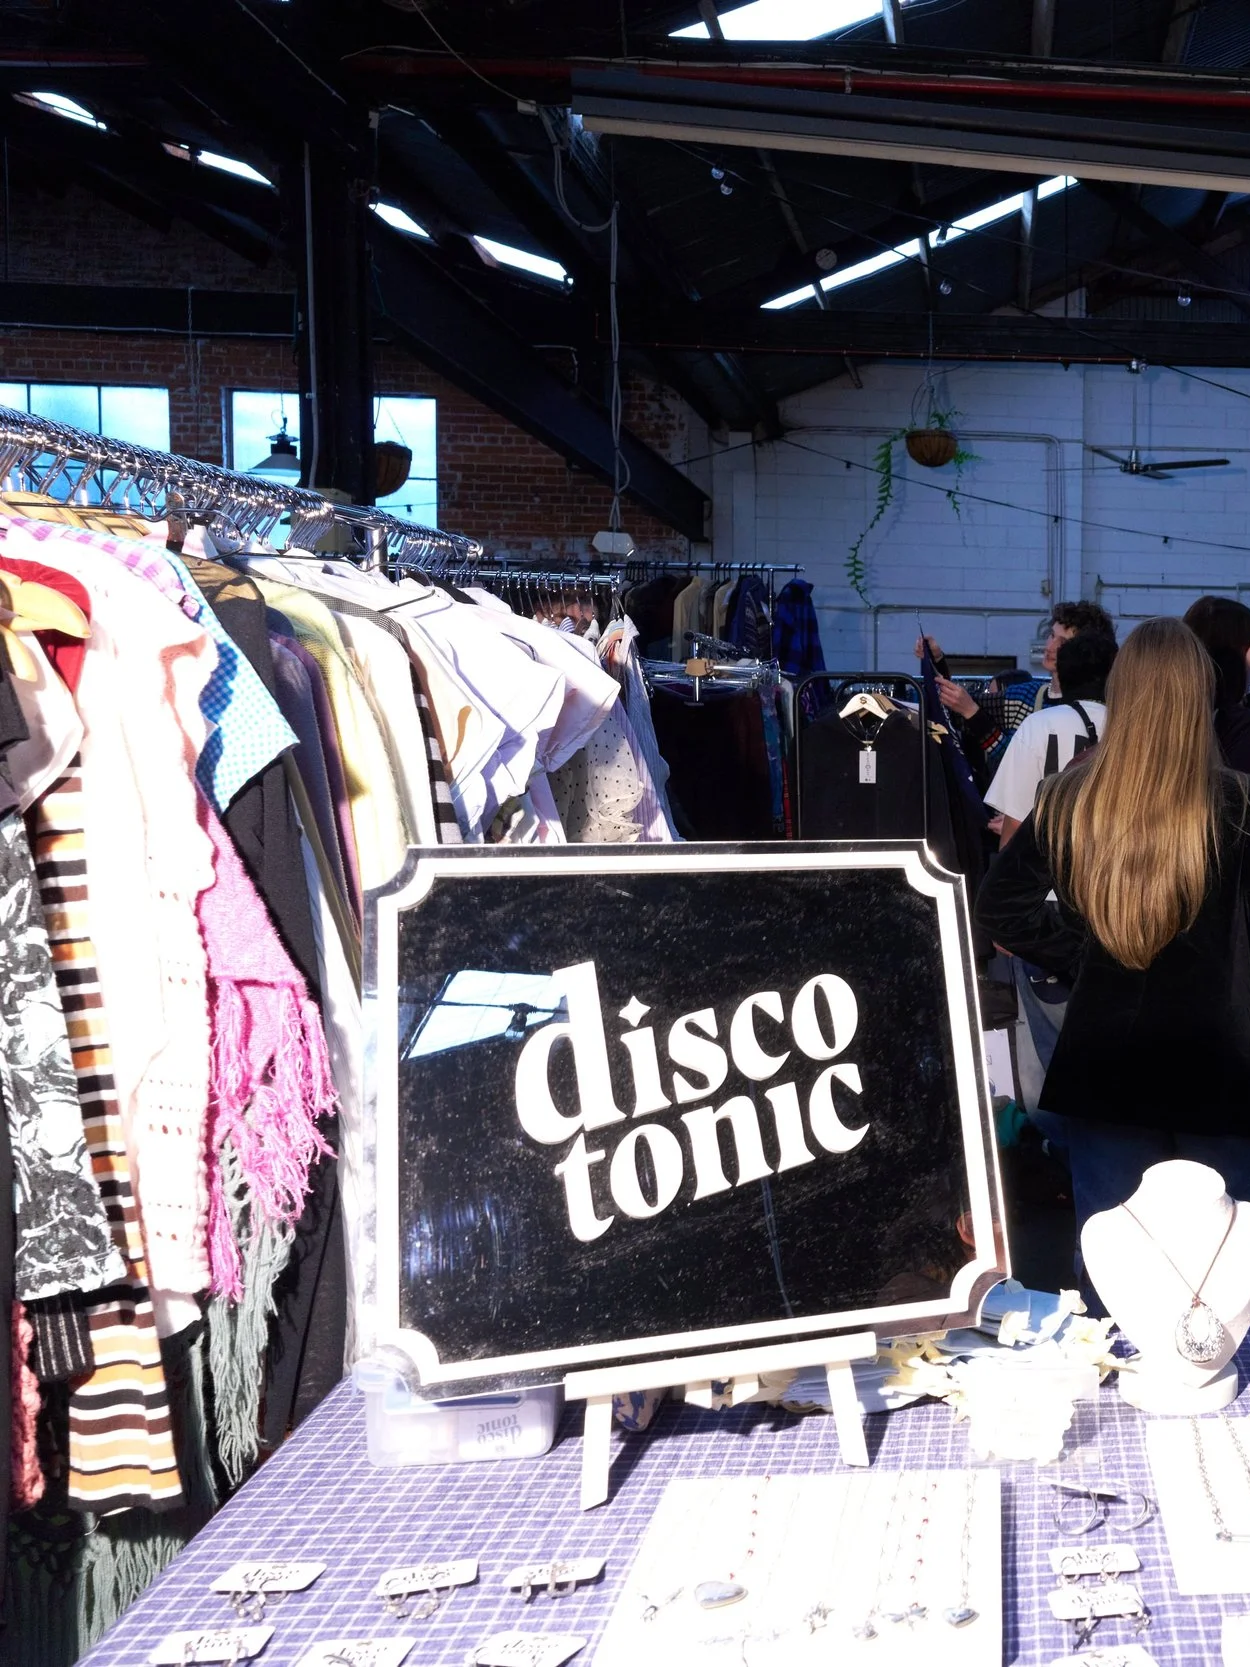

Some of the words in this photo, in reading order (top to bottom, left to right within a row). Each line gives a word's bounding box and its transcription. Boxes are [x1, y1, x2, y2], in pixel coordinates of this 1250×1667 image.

[514, 960, 859, 1145] disco
[555, 1062, 870, 1242] tonic
[476, 1414, 518, 1435] tonic
[476, 1424, 522, 1445] disco
